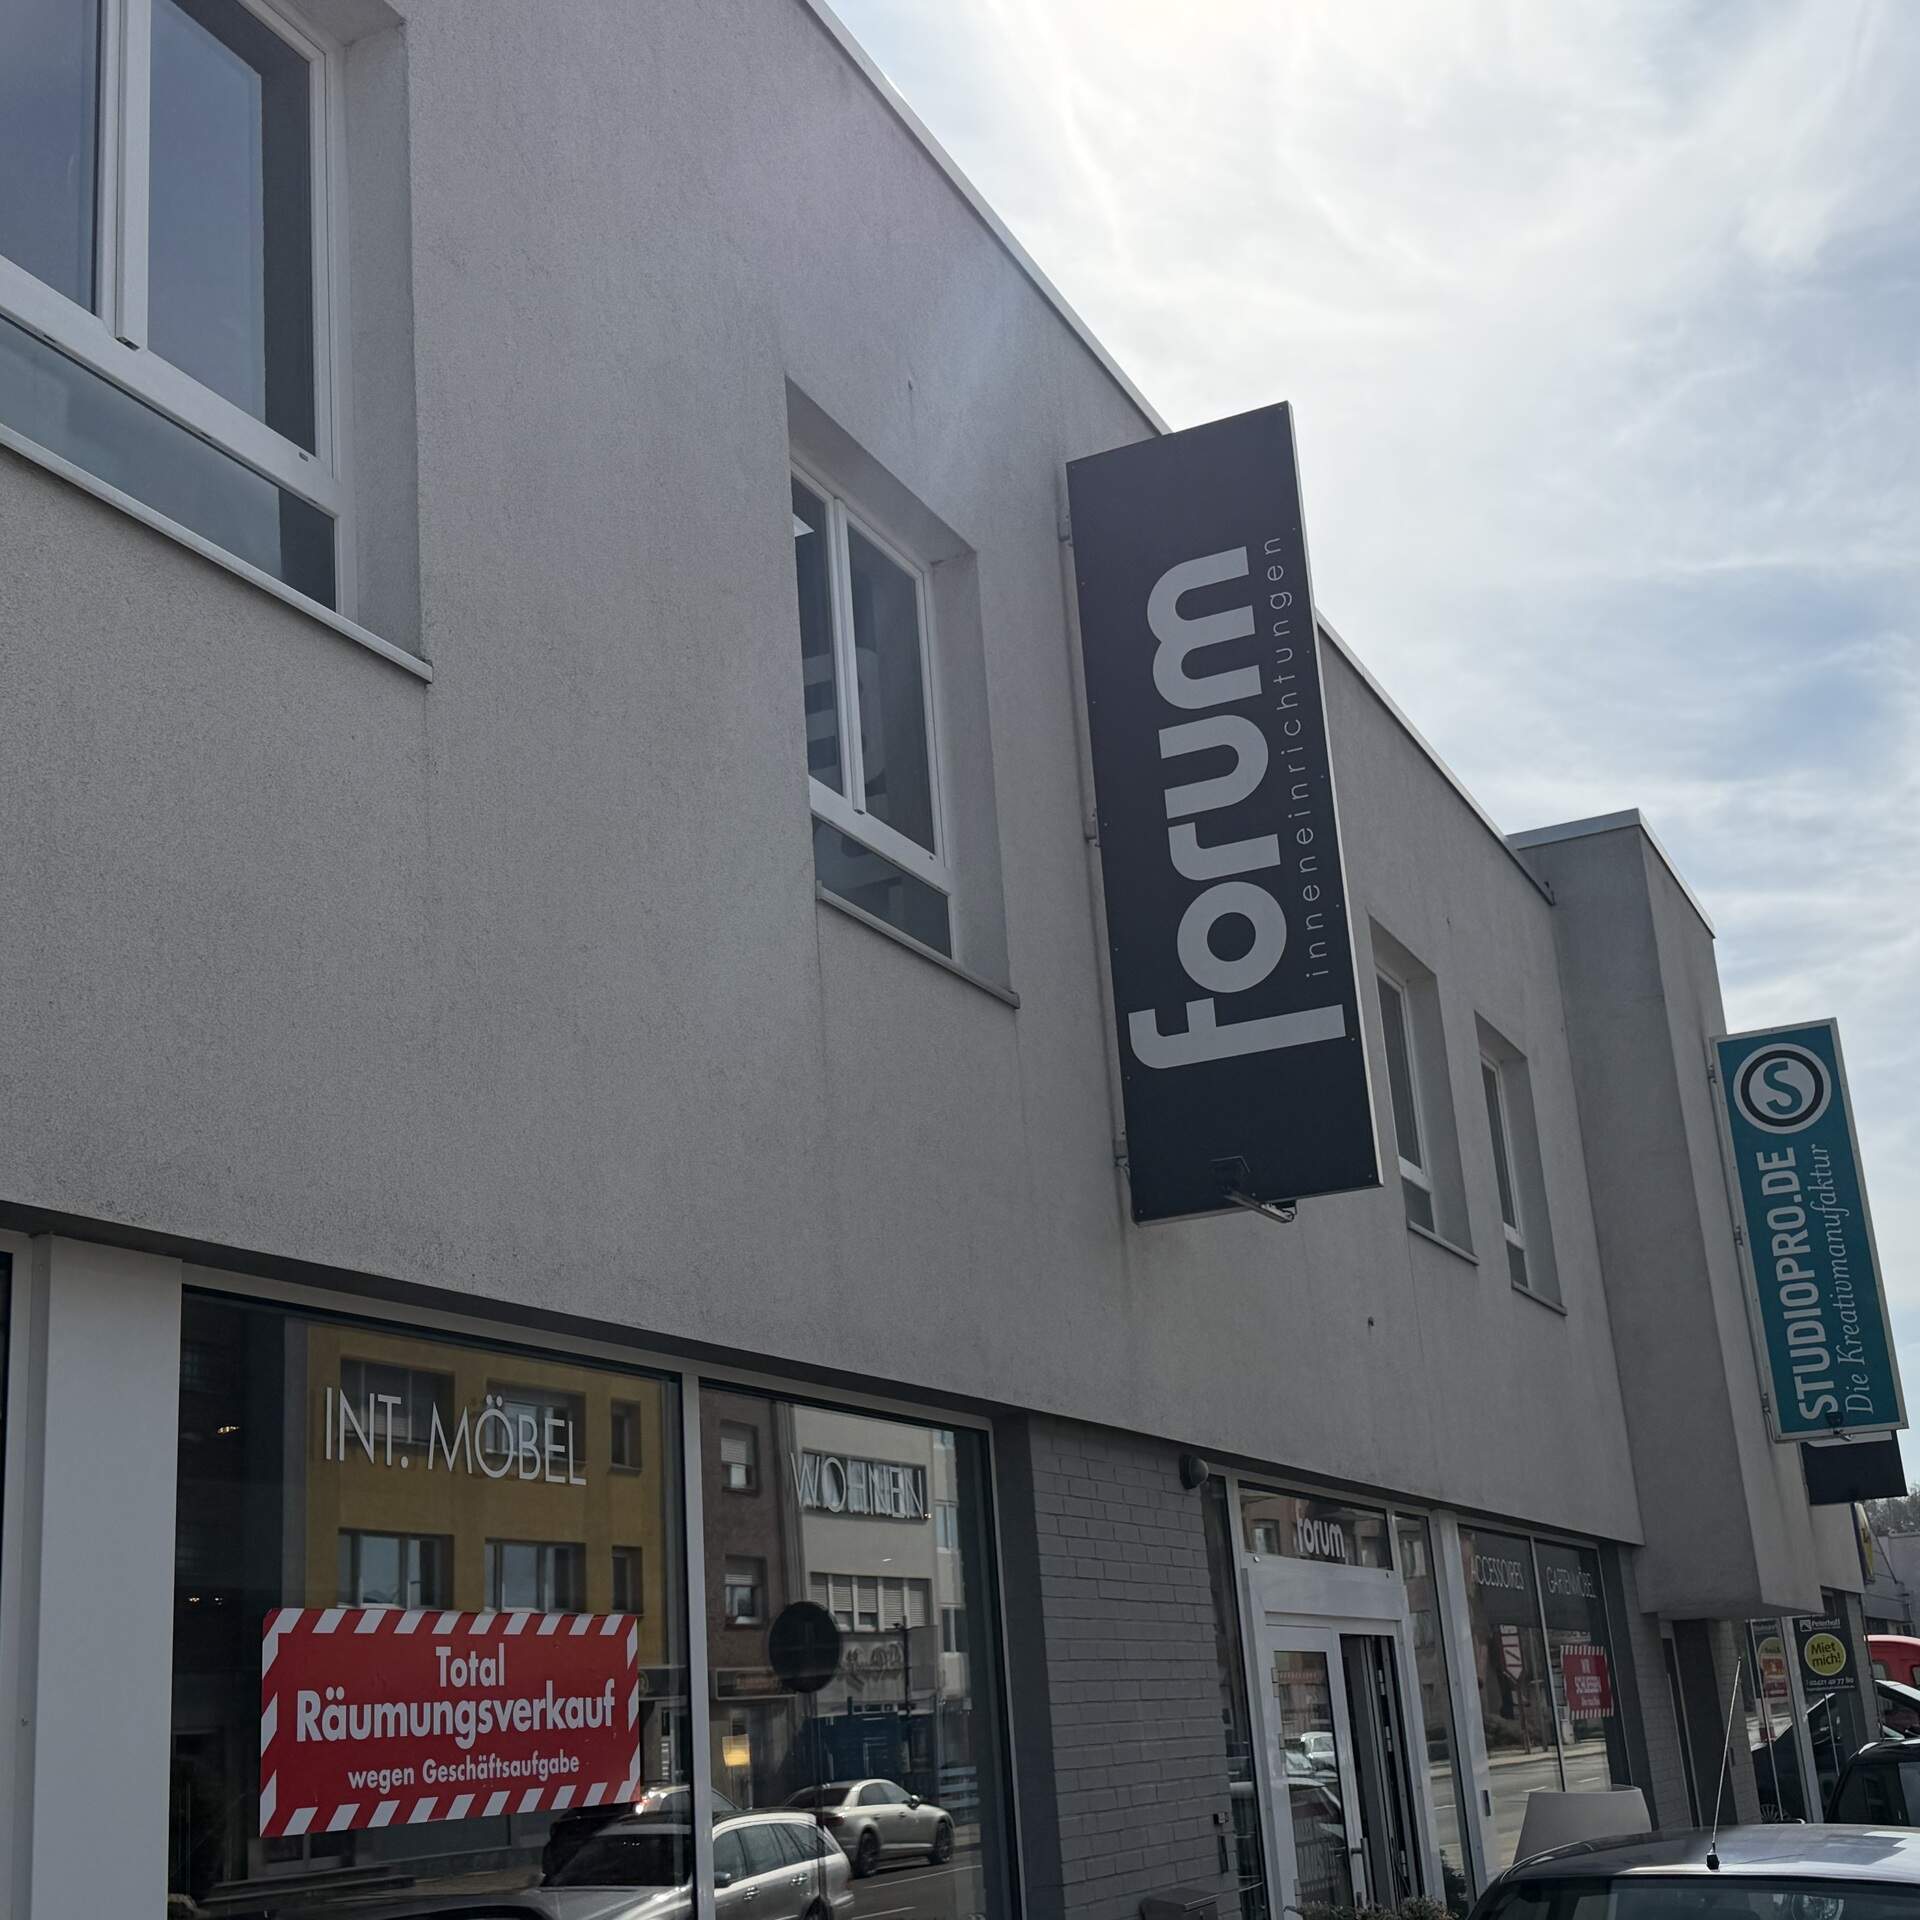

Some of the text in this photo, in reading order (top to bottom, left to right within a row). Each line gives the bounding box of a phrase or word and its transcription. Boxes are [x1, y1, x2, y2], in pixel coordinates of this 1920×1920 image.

[1263, 536, 1329, 979] inneneinrichtungen
[1128, 545, 1347, 1070] forum
[1756, 1146, 1839, 1420] STUDIOPRO.DE
[1807, 1142, 1875, 1415] Die Kreativmanufaktur
[325, 1387, 587, 1486] INT. MÖBEL
[789, 1451, 926, 1520] WOHNEN
[435, 1642, 505, 1688] Total
[1810, 1641, 1836, 1655] Miet
[1811, 1651, 1841, 1668] mich!
[296, 1677, 616, 1750] Räumungsverkauf
[347, 1749, 580, 1794] wegen Geschäftsaufgabe
